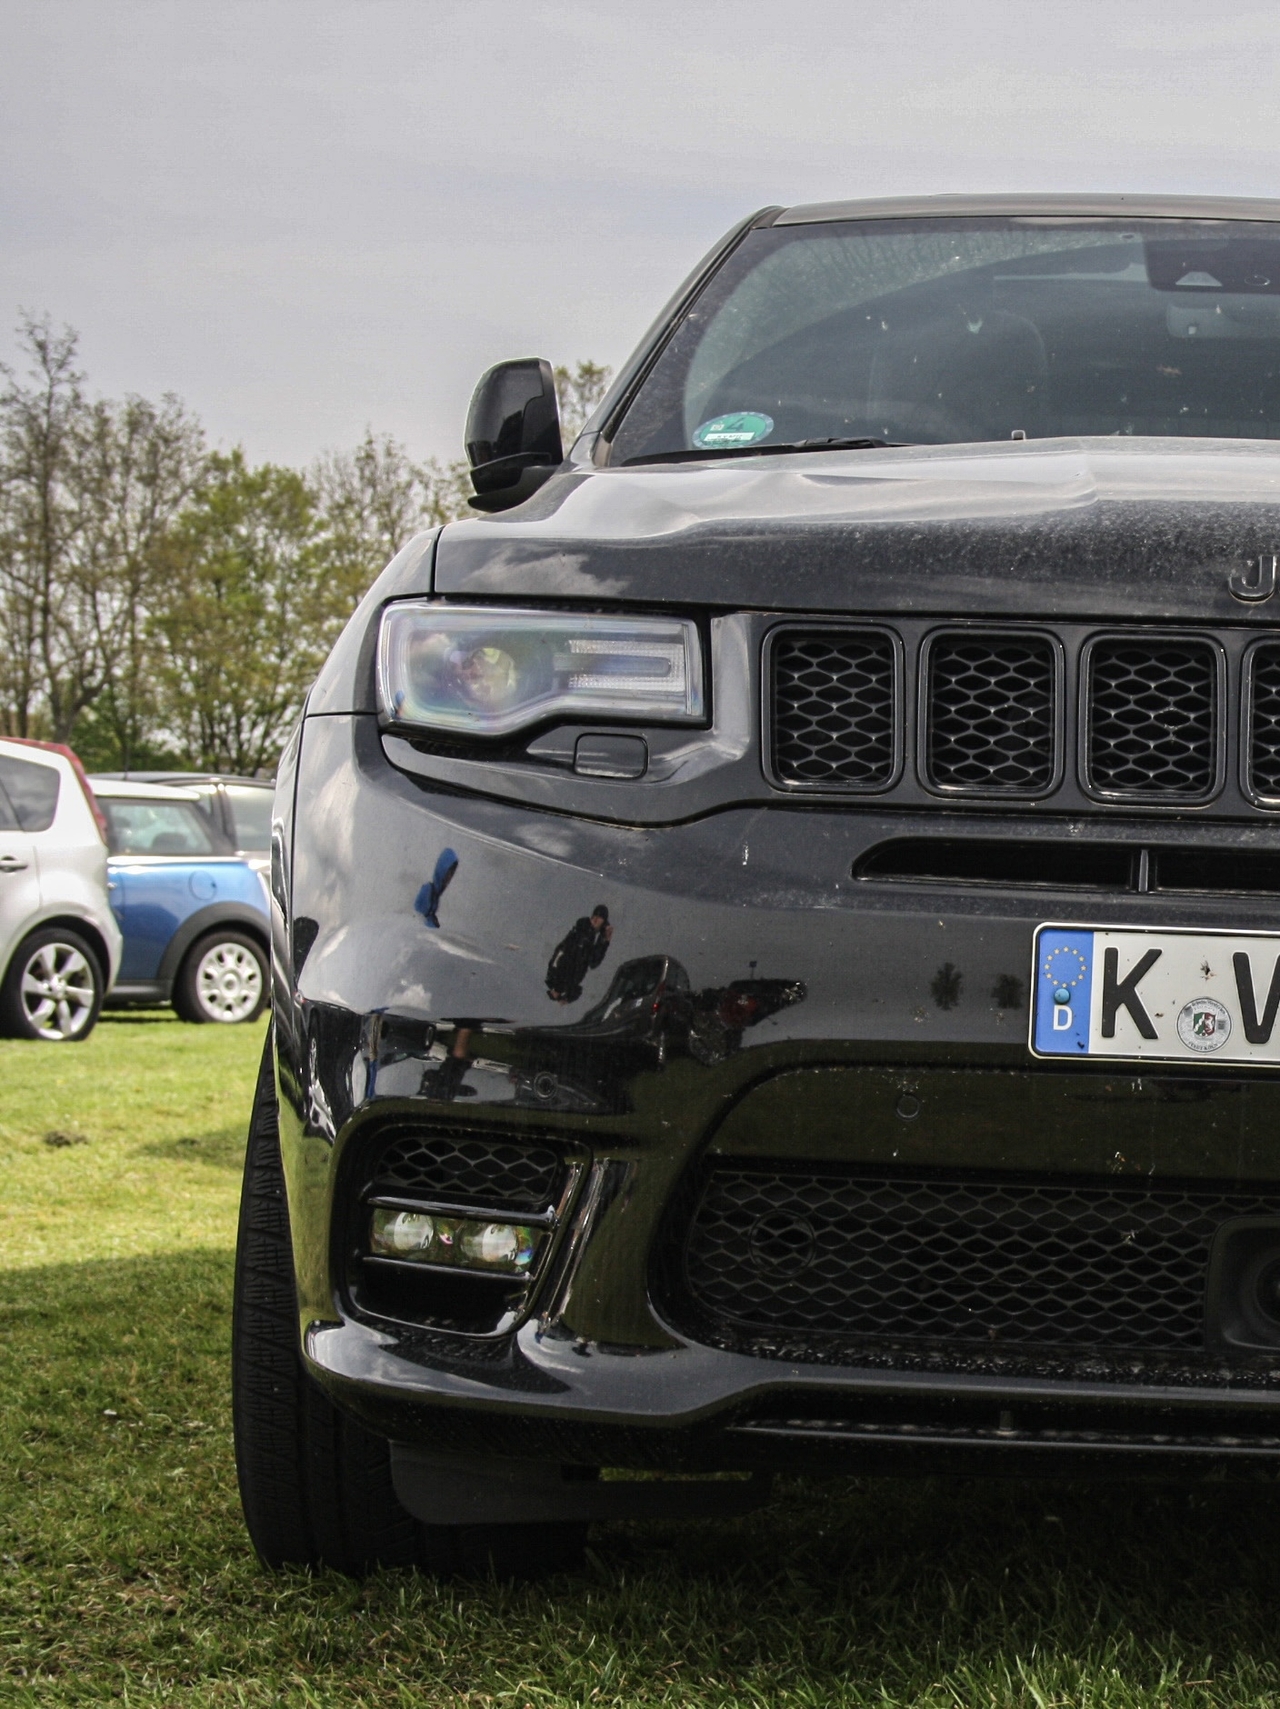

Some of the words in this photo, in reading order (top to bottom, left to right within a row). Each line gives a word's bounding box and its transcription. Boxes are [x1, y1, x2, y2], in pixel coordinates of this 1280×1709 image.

[727, 417, 745, 432] 4
[1101, 947, 1163, 1040] K
[1053, 1004, 1073, 1031] D
